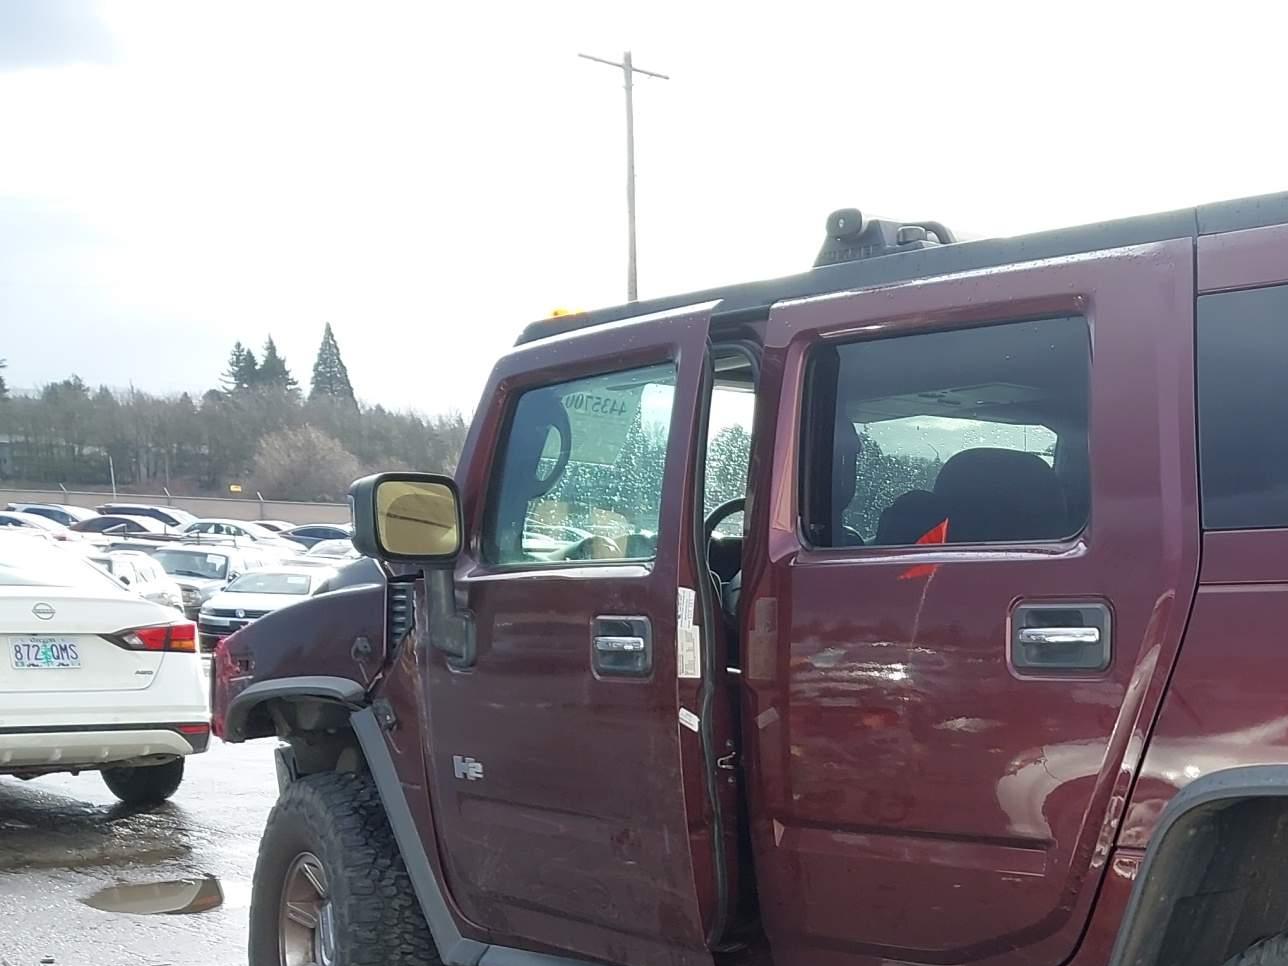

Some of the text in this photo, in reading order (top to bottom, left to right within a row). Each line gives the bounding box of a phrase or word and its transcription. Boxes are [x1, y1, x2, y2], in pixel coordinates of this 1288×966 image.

[14, 643, 79, 661] 872 QMS
[453, 755, 484, 780] H2
